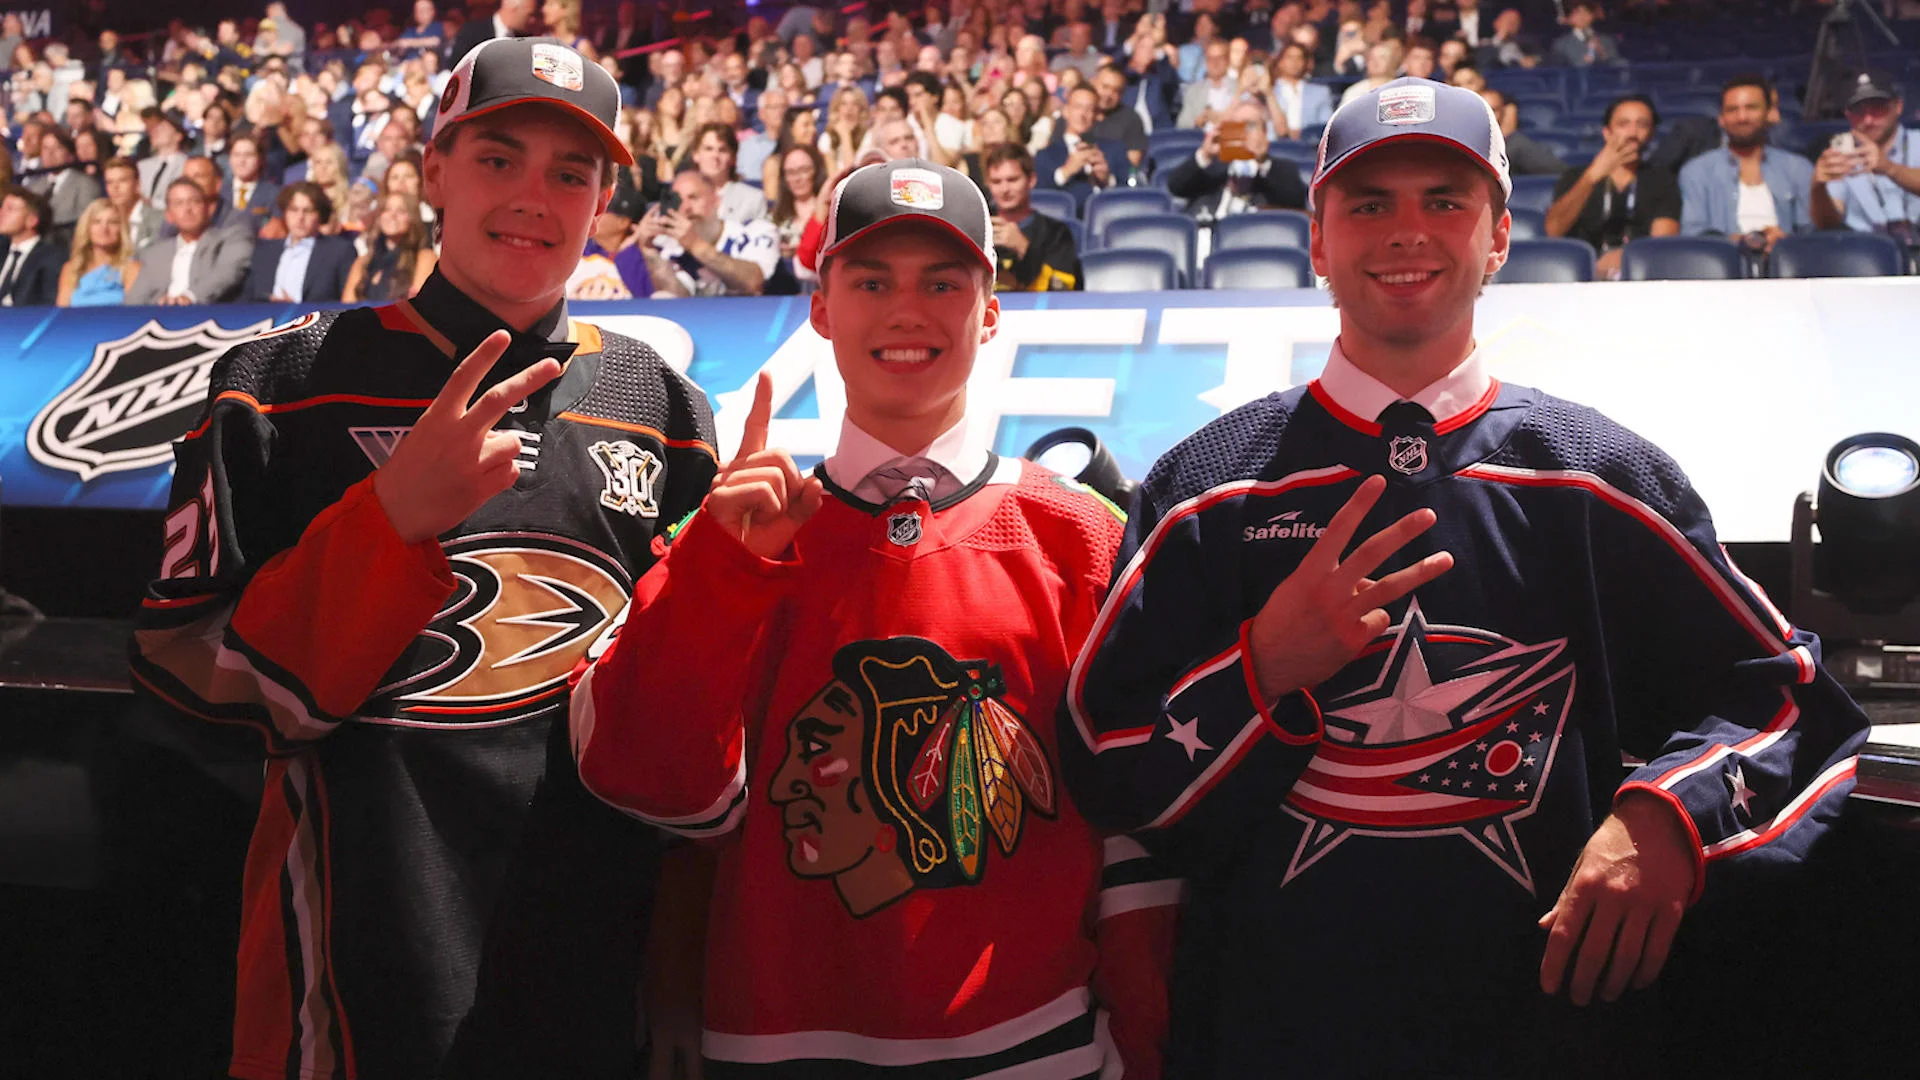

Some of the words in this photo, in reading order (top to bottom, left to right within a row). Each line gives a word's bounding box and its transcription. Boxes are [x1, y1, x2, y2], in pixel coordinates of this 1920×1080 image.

[67, 360, 212, 438] NHL
[567, 306, 1341, 480] AFT
[609, 453, 649, 502] 30
[1397, 444, 1422, 468] NHL
[1242, 522, 1328, 542] Safelite
